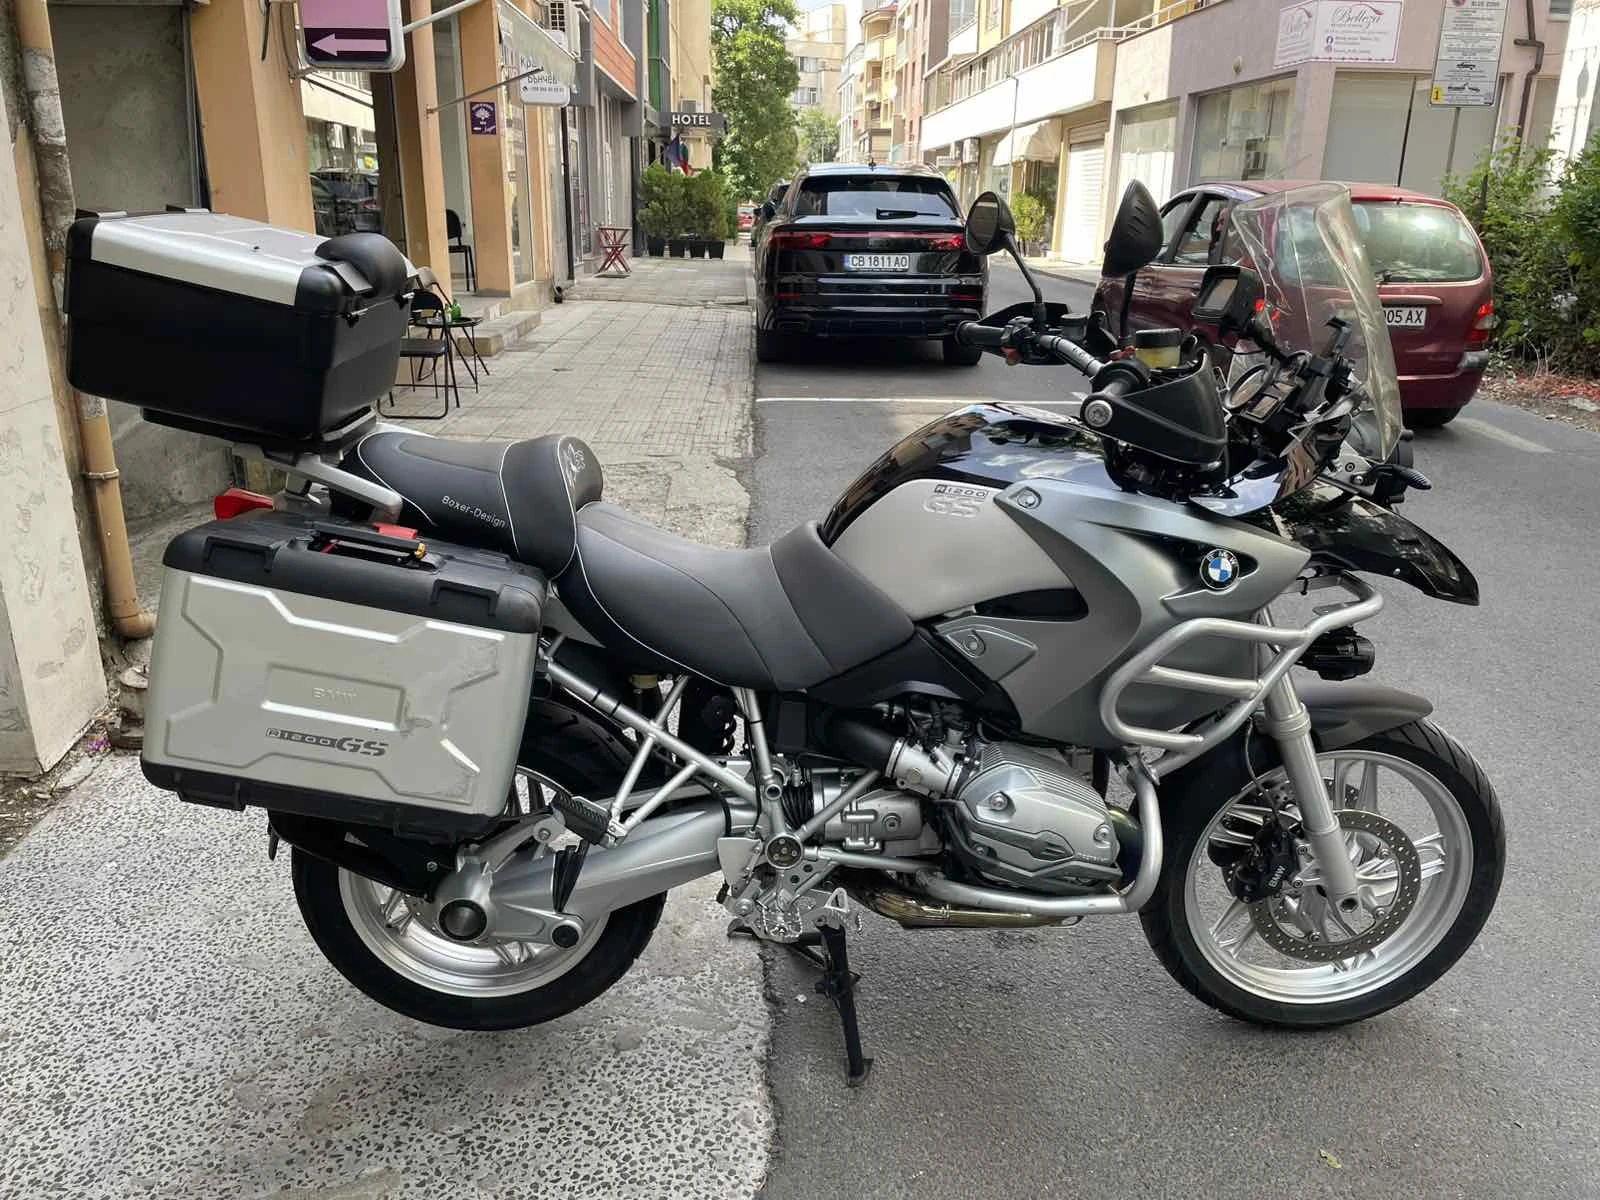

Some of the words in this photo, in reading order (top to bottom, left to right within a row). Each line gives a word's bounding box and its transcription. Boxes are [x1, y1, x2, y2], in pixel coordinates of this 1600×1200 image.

[672, 114, 711, 125] HOTEL
[851, 256, 865, 267] CB
[868, 256, 891, 268] 1811
[1406, 310, 1423, 323] AX
[934, 483, 989, 499] R1200
[441, 495, 506, 528] Boxer-Design
[922, 495, 981, 518] GS
[1206, 551, 1237, 565] BMW
[1268, 865, 1285, 888] BMW
